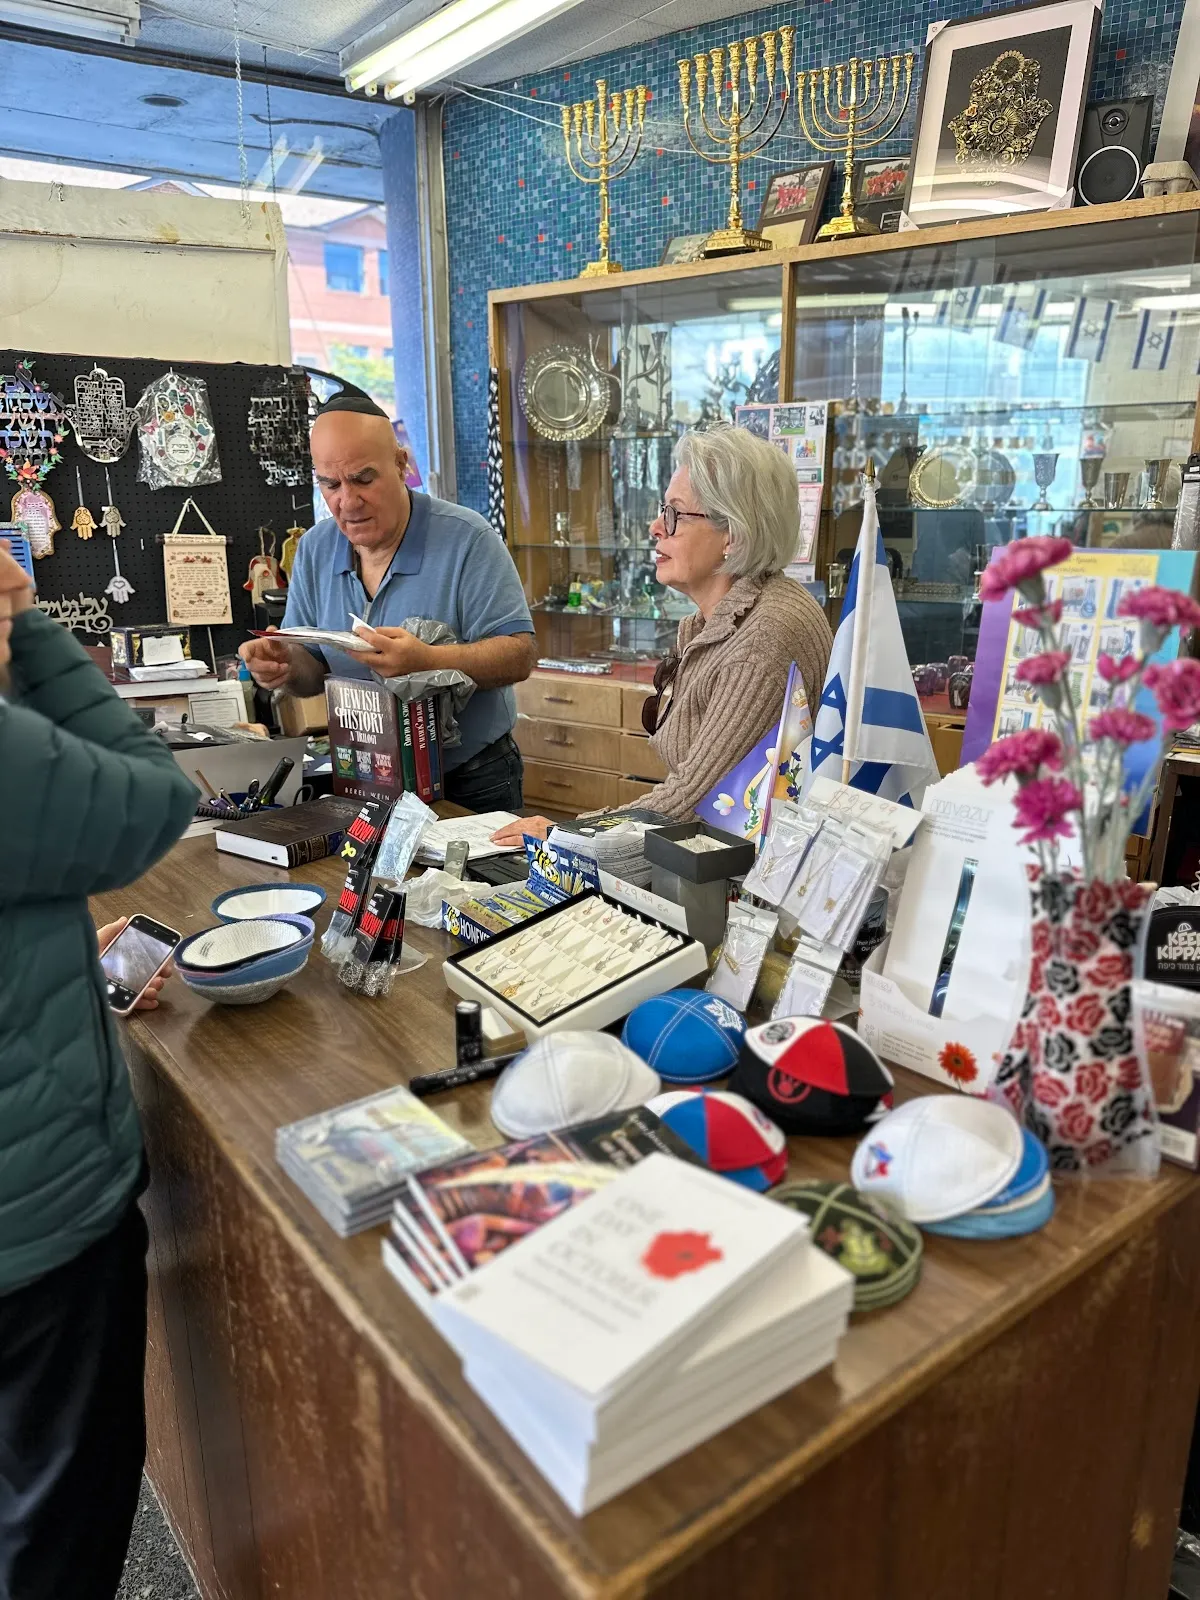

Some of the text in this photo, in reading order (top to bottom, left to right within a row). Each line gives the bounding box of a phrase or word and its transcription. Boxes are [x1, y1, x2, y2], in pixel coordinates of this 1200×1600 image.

[340, 687, 381, 713] JEWISH
[334, 706, 384, 735] HISTORY
[350, 730, 377, 745] A TRILOGY
[344, 787, 390, 801] BEREL WEIN
[348, 817, 376, 843] NOW!
[339, 888, 359, 911] NOW!
[360, 911, 383, 937] NOW!
